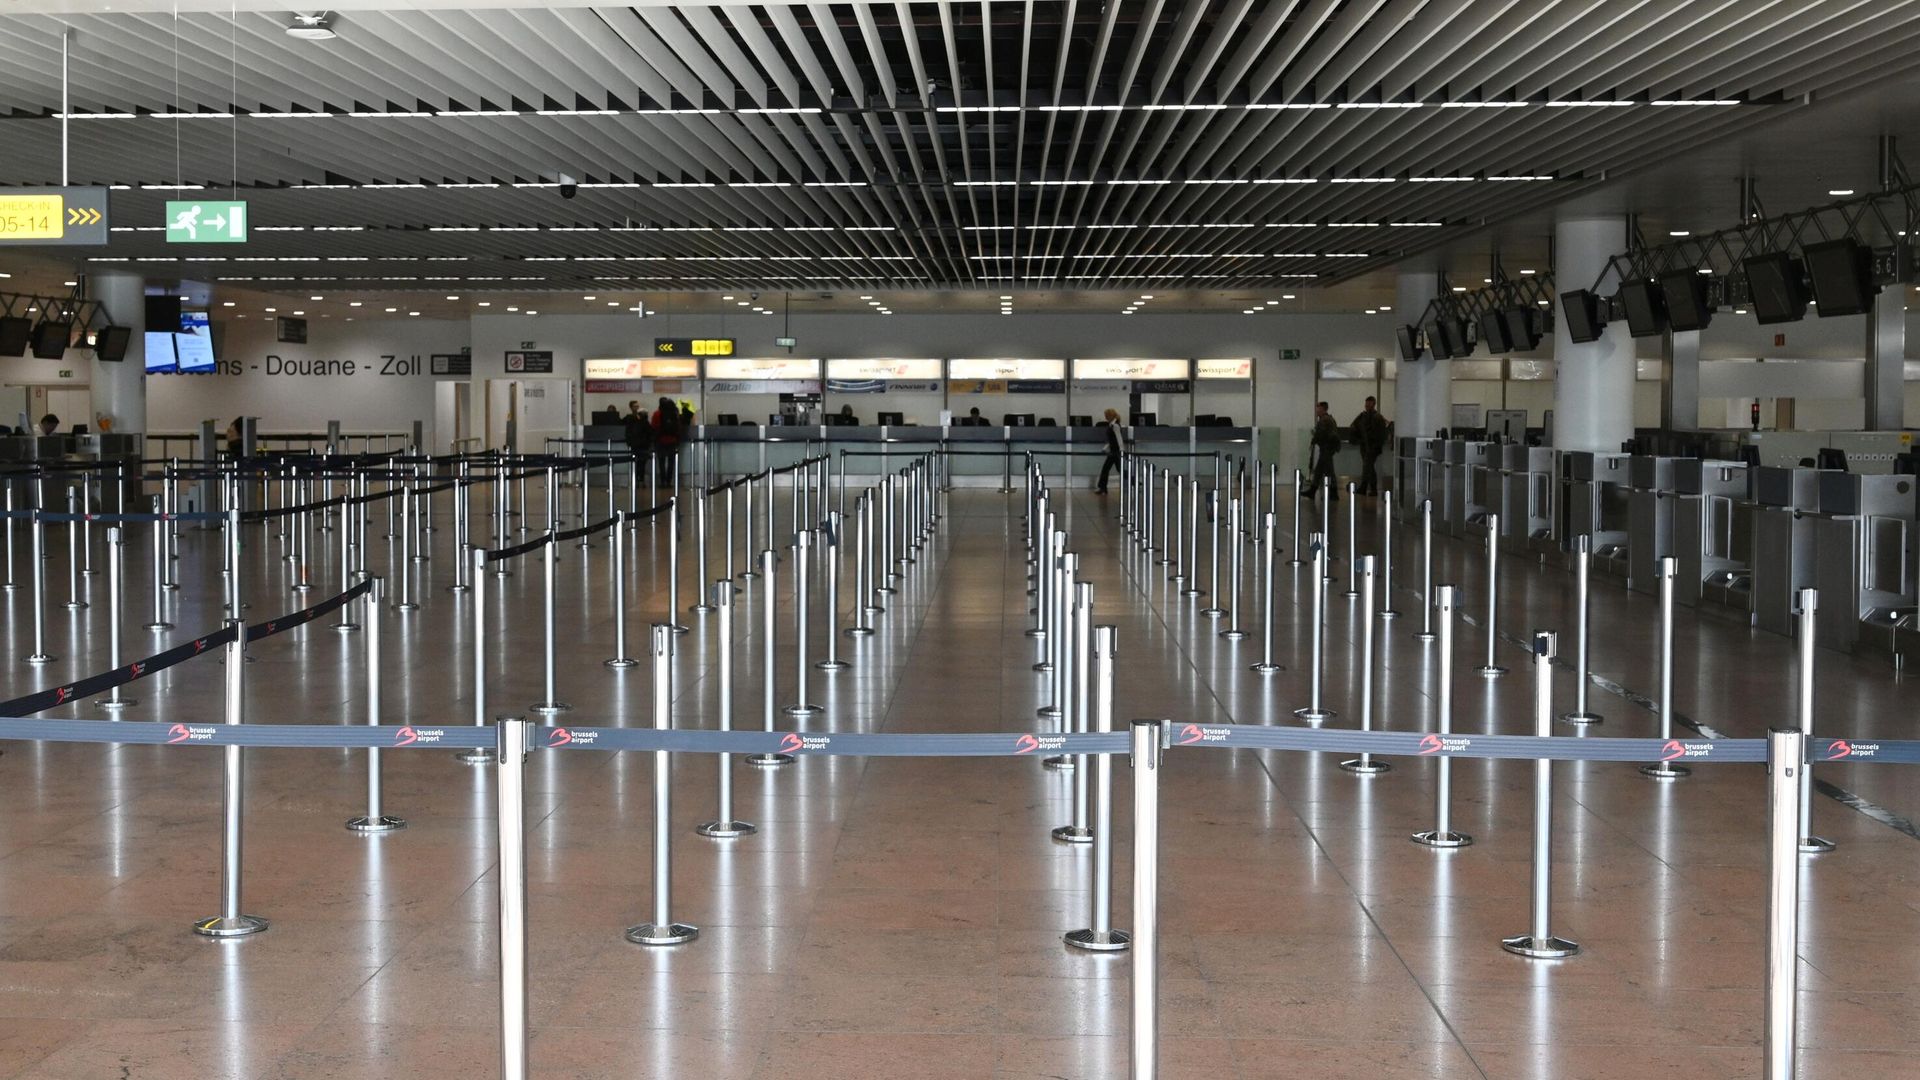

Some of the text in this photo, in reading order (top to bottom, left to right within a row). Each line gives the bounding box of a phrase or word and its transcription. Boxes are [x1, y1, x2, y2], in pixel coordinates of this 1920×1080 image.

[0, 201, 50, 211] HECK-IN
[266, 355, 355, 376] Douane
[379, 355, 420, 376] Zoll
[587, 366, 625, 375] swissport
[1198, 367, 1236, 375] swissport
[1038, 742, 1061, 750] airport
